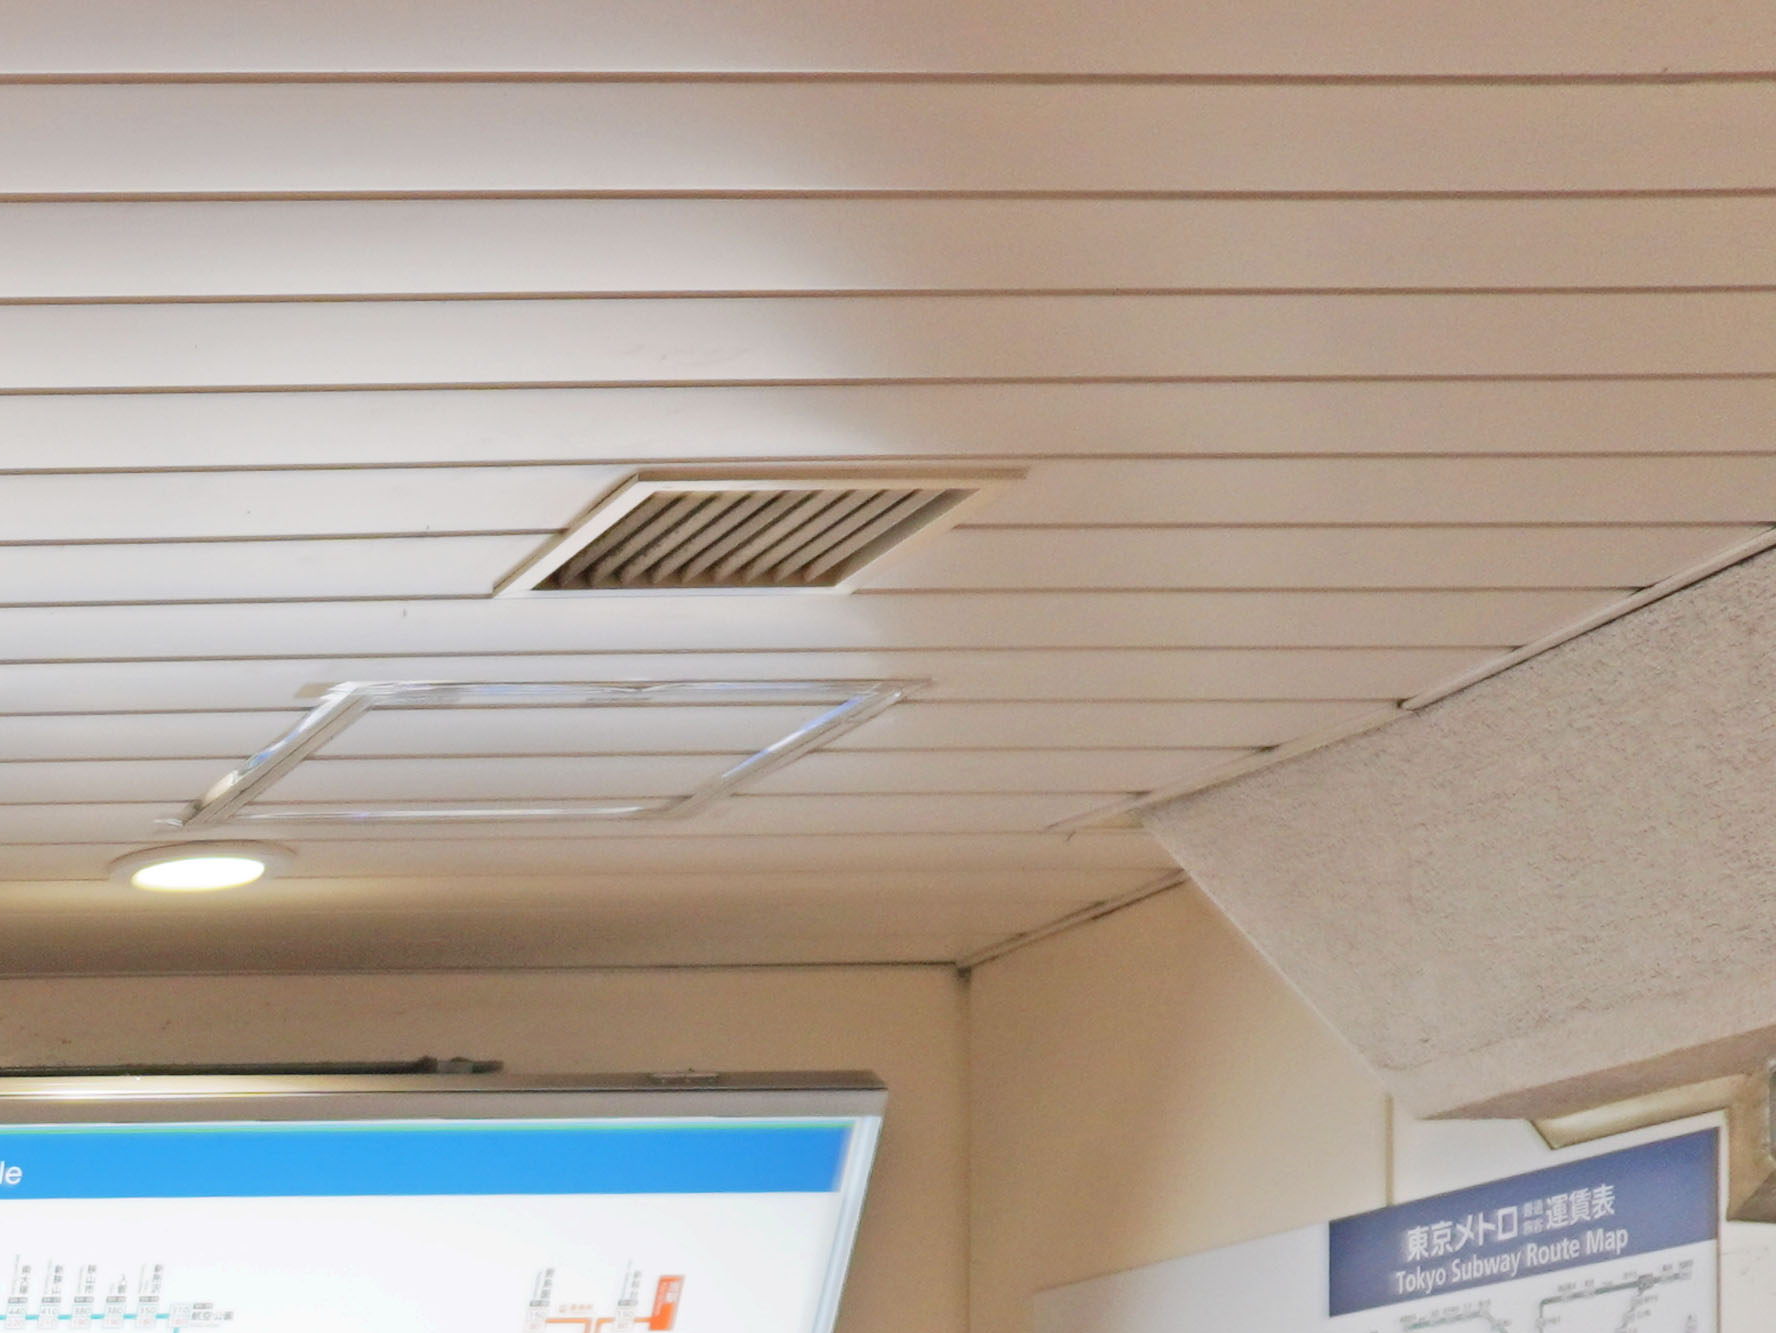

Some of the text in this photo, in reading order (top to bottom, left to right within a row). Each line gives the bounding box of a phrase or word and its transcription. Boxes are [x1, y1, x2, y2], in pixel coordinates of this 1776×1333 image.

[1396, 1228, 1628, 1295] Tokyo Subway Route Map
[1406, 1205, 1517, 1261] 東京メトロ
